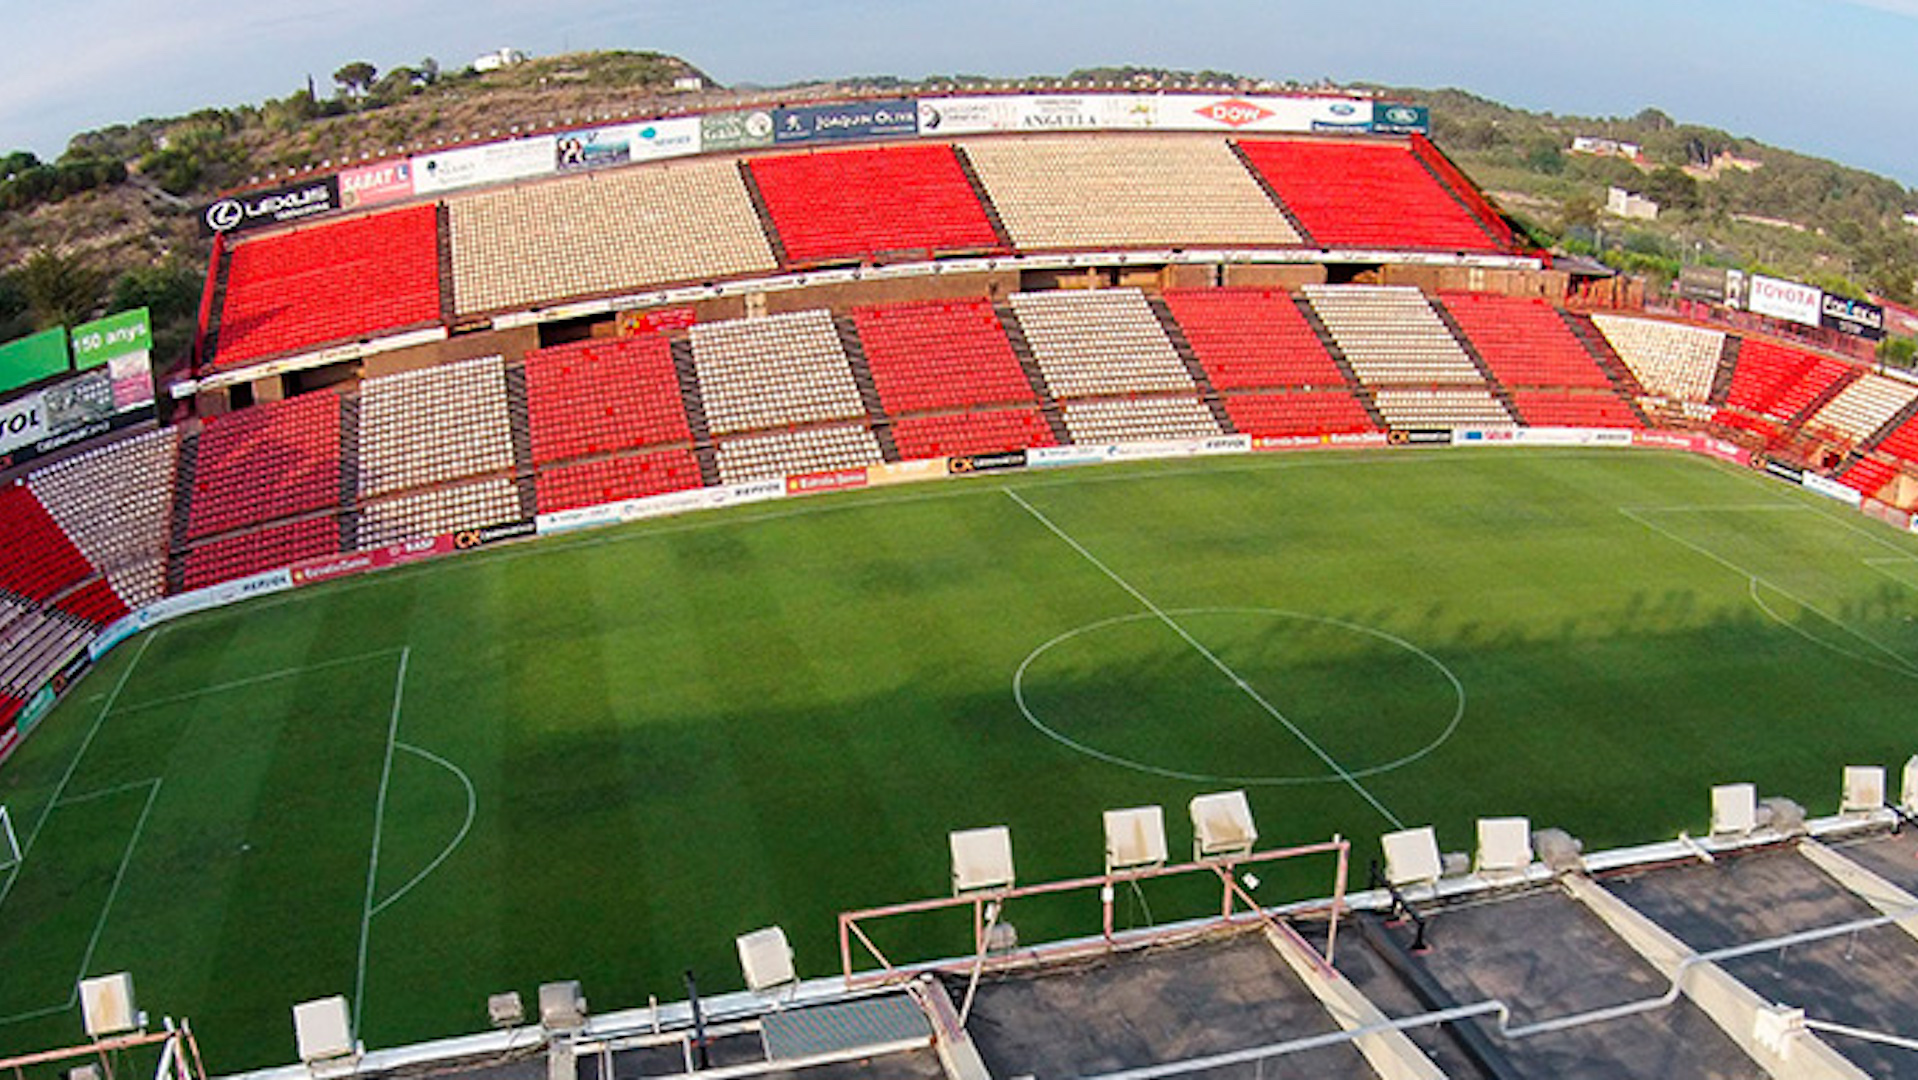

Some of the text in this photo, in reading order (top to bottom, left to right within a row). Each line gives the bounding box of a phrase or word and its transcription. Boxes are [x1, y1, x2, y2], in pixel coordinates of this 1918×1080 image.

[245, 185, 330, 217] LEXUS
[1755, 281, 1816, 307] TOYOTA
[73, 323, 147, 353] 150 anys
[455, 525, 481, 549] CX
